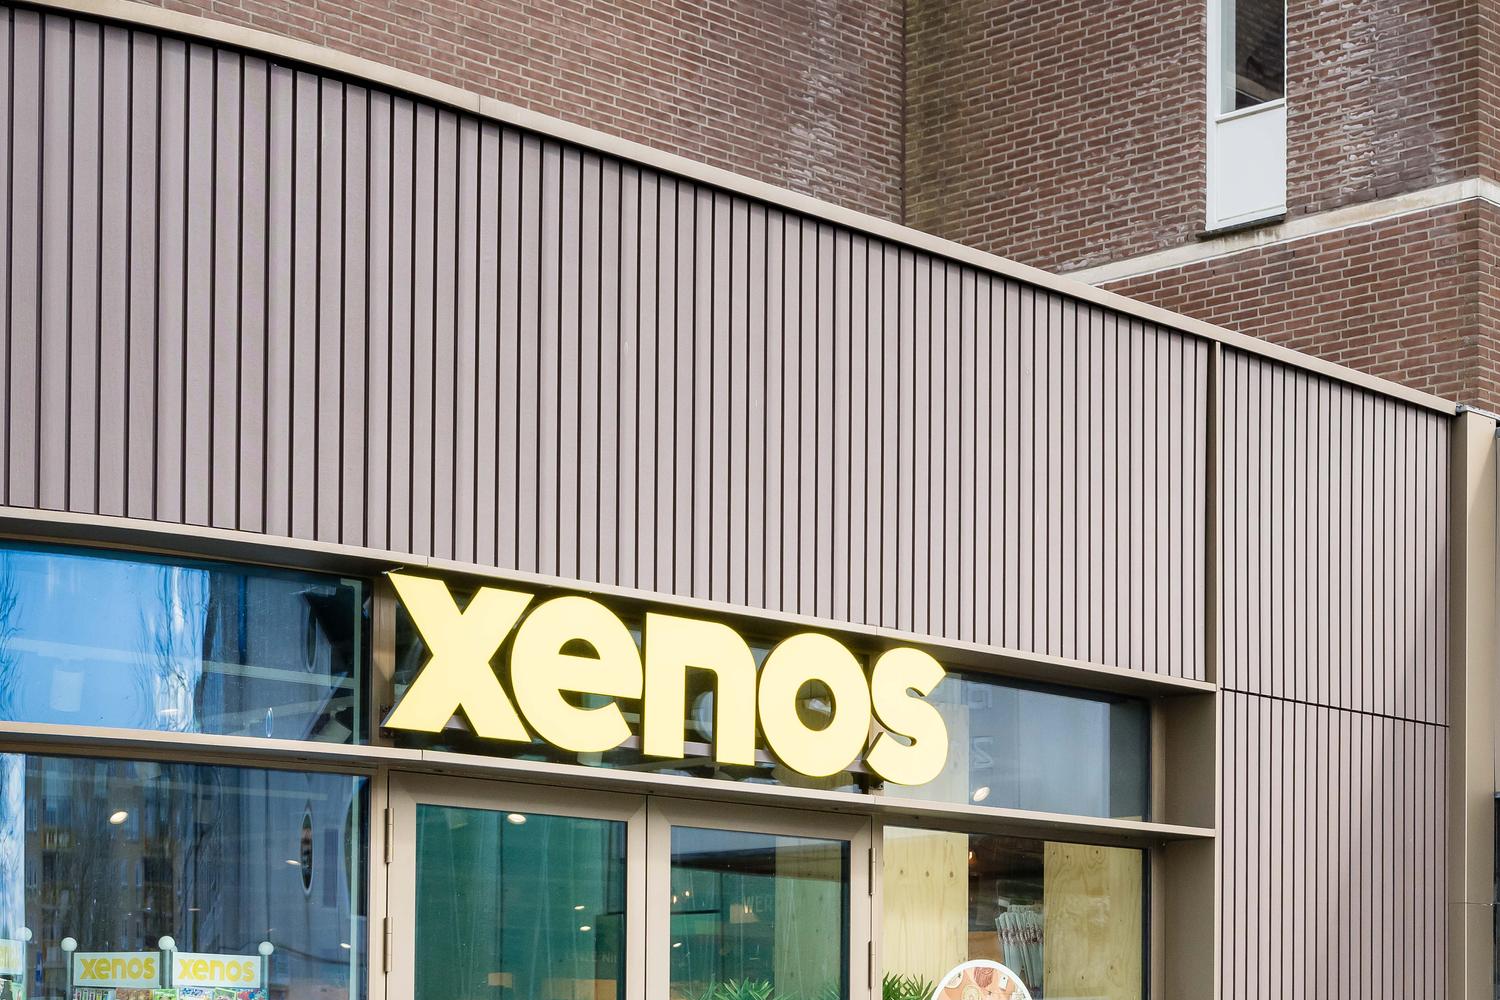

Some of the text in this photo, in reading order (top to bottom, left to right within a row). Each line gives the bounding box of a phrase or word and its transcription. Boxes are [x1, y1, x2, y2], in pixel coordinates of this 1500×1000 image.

[382, 572, 949, 787] xenos
[79, 957, 156, 980] xenos
[178, 958, 255, 982] xenos
